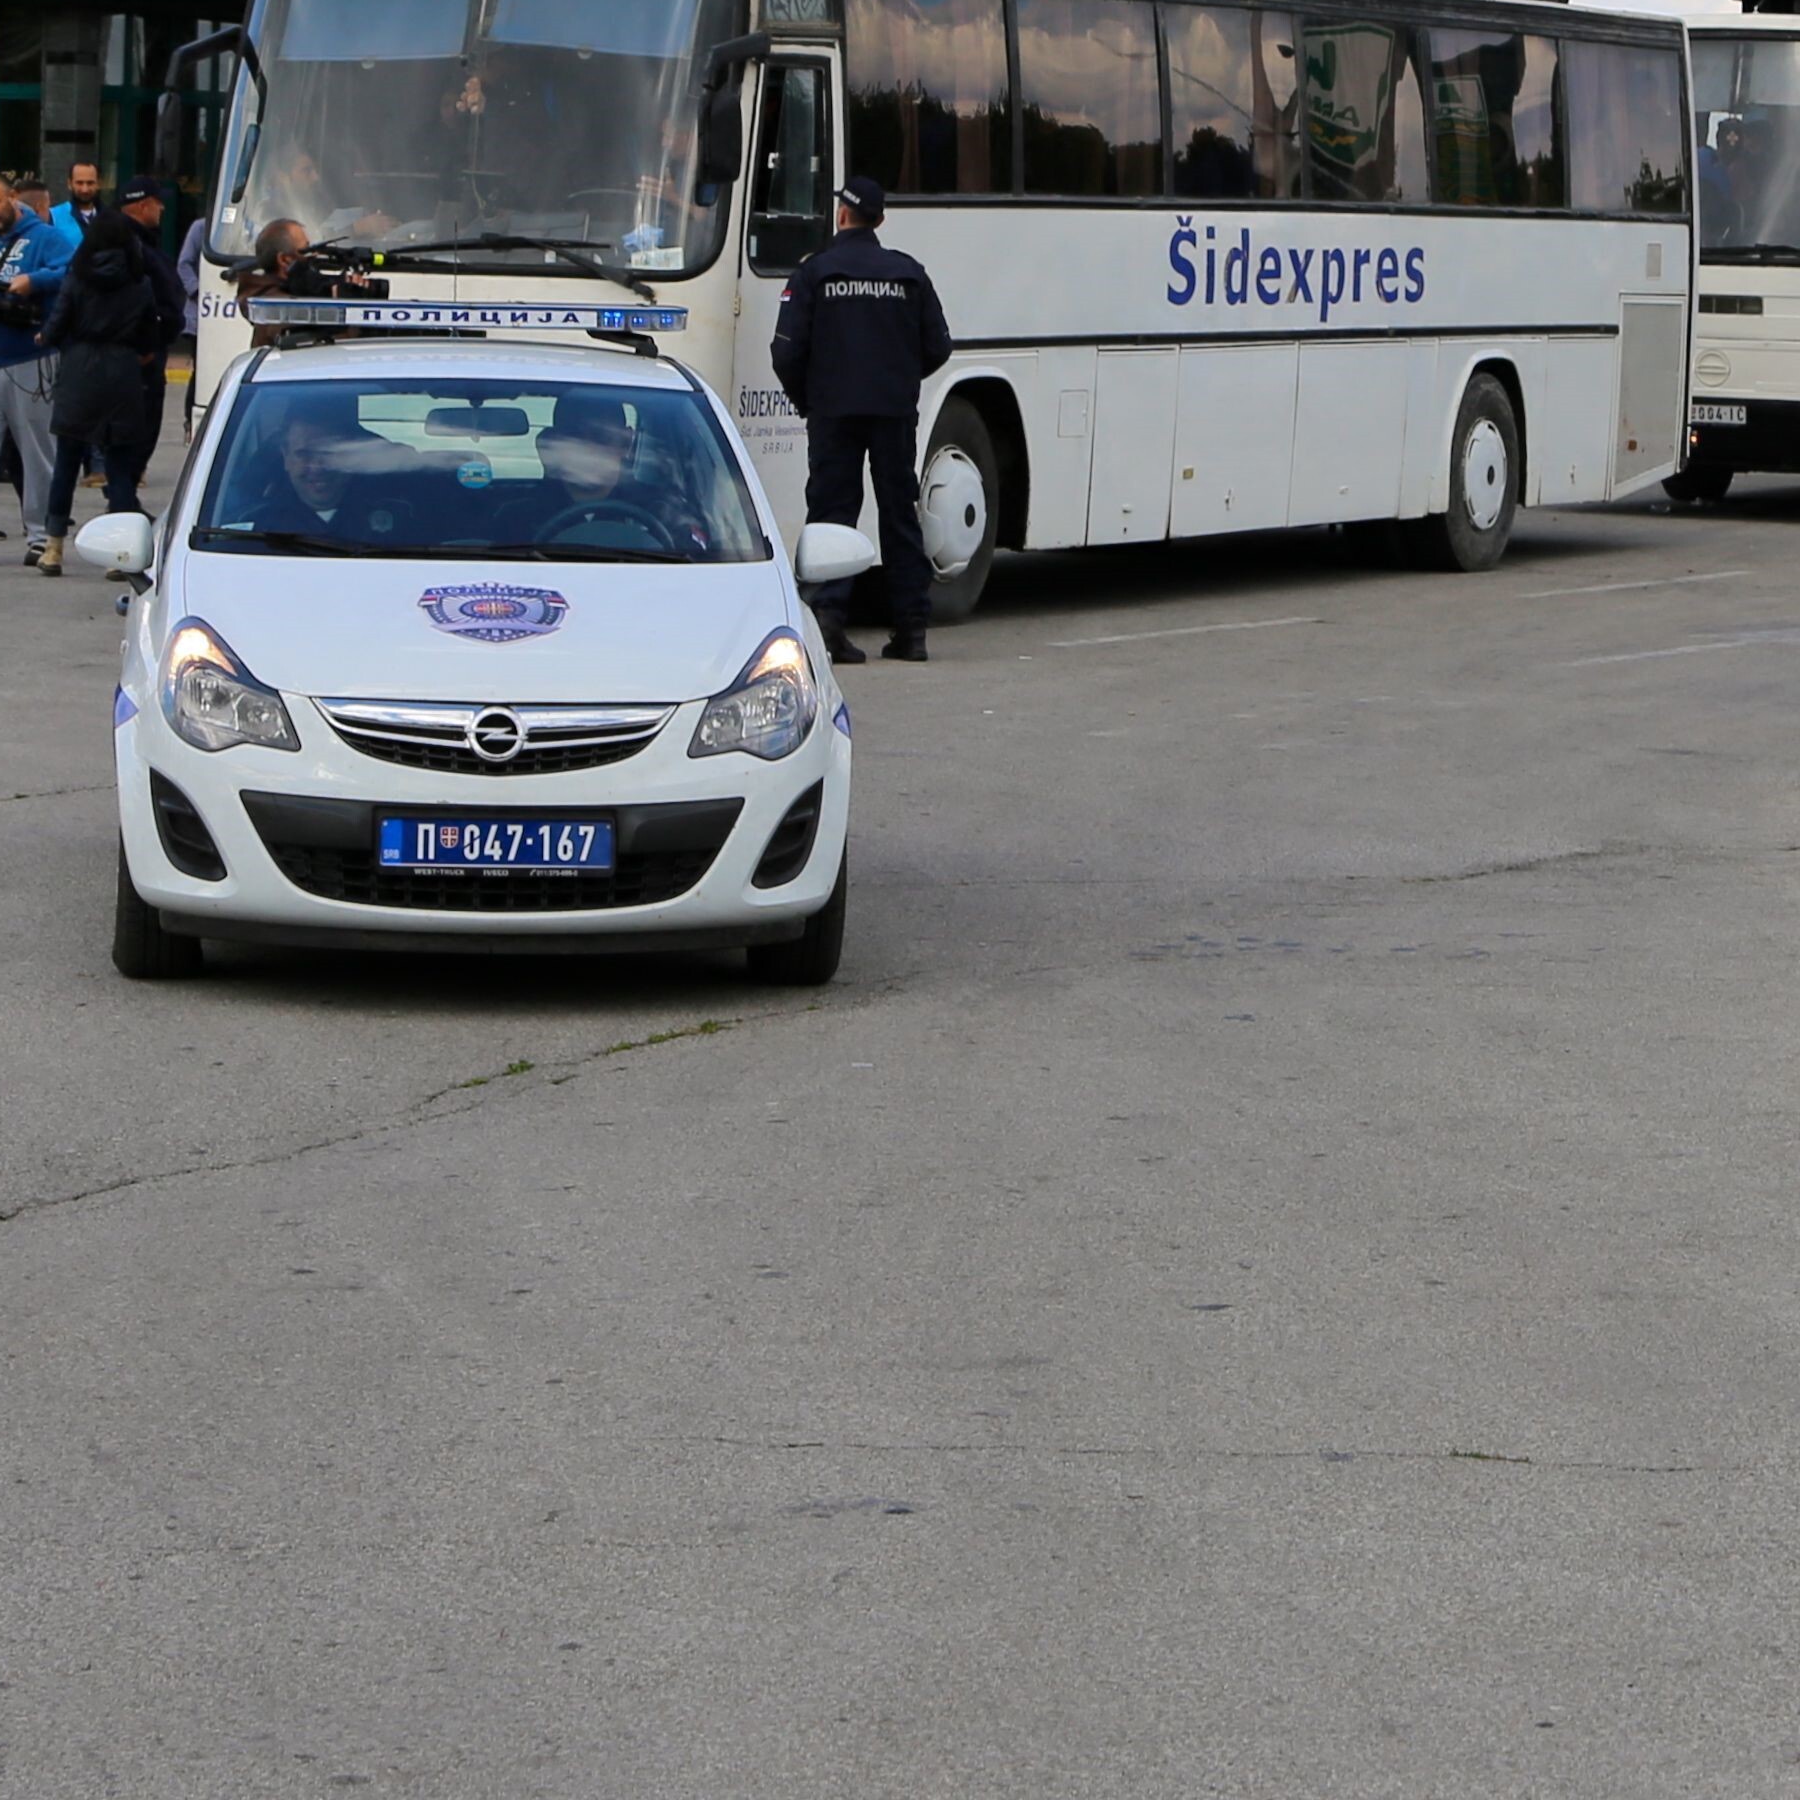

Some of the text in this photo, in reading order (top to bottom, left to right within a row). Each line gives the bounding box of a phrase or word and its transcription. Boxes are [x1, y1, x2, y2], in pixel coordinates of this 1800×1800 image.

[1167, 215, 1425, 323] Šidexpres
[824, 280, 907, 299] ПОЛИЦИЈА
[362, 309, 580, 324] ПОЛИЦИЈА
[762, 442, 794, 455] SRBIJA
